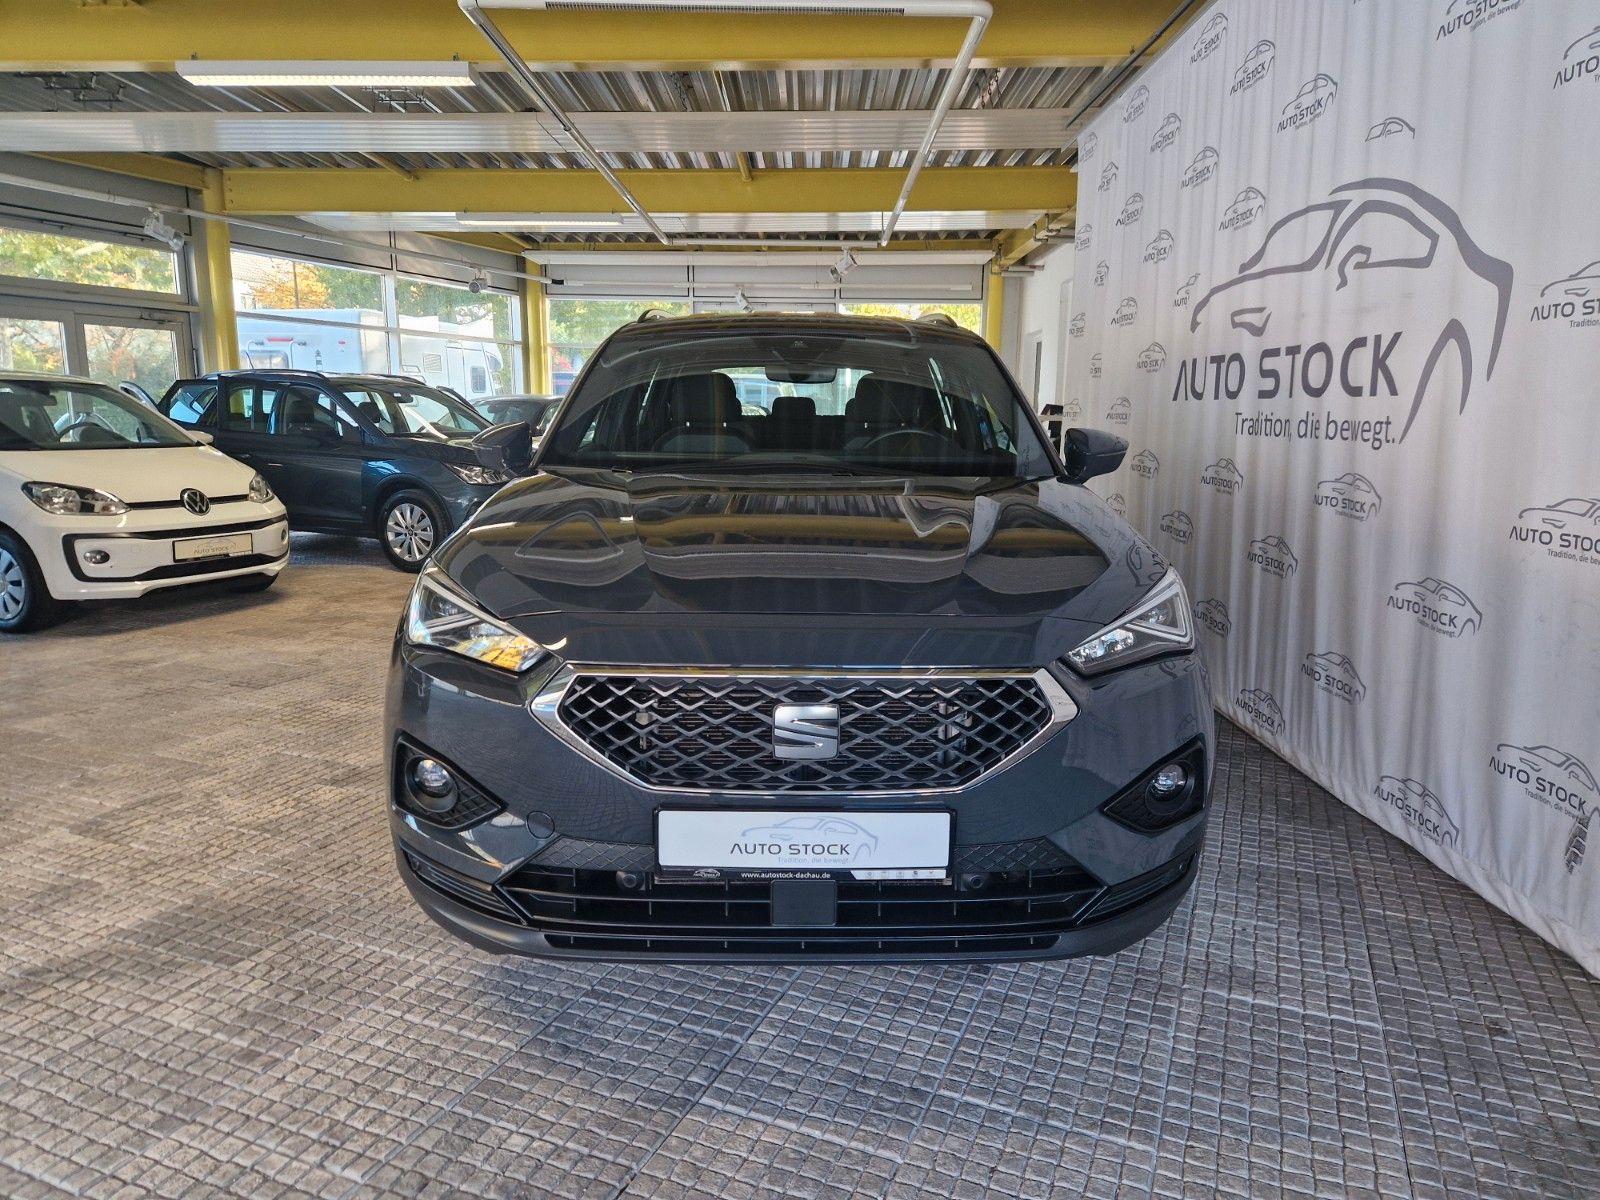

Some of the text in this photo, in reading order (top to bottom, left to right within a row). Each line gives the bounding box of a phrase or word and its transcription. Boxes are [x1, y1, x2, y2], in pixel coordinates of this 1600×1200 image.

[1436, 10, 1474, 40] AUTO
[1230, 79, 1246, 97] AUTO
[1246, 61, 1266, 85] STOCK
[1553, 55, 1600, 90] AUTO
[1277, 114, 1298, 134] AUTO
[1299, 96, 1324, 122] STOCK
[1219, 217, 1236, 231] AUTO
[1236, 207, 1254, 226] STOCK
[1531, 302, 1575, 321] AUTO
[1172, 331, 1403, 402] AUTO STOCK
[1235, 411, 1396, 450] Tradition, die bewegt.
[1200, 476, 1233, 489] AUTO STOCK
[1313, 495, 1367, 514] AUTO STOCK
[1509, 526, 1600, 554] AUTO STOC
[1247, 550, 1264, 565] AUTO
[1264, 556, 1285, 573] STOCK
[1387, 595, 1421, 614] AUTO
[1421, 605, 1458, 629] STOCK
[1301, 663, 1322, 682] AUTO
[1324, 674, 1354, 697] STOCK
[1236, 697, 1254, 715] AUTO
[1254, 710, 1275, 729] STOCK
[1489, 756, 1587, 815] AUTO STOCK
[1374, 785, 1405, 810] AUTO
[1404, 804, 1440, 837] STOCK
[730, 843, 850, 855] AUTO STOCK
[741, 871, 831, 880] www.autostock-dachau.de
